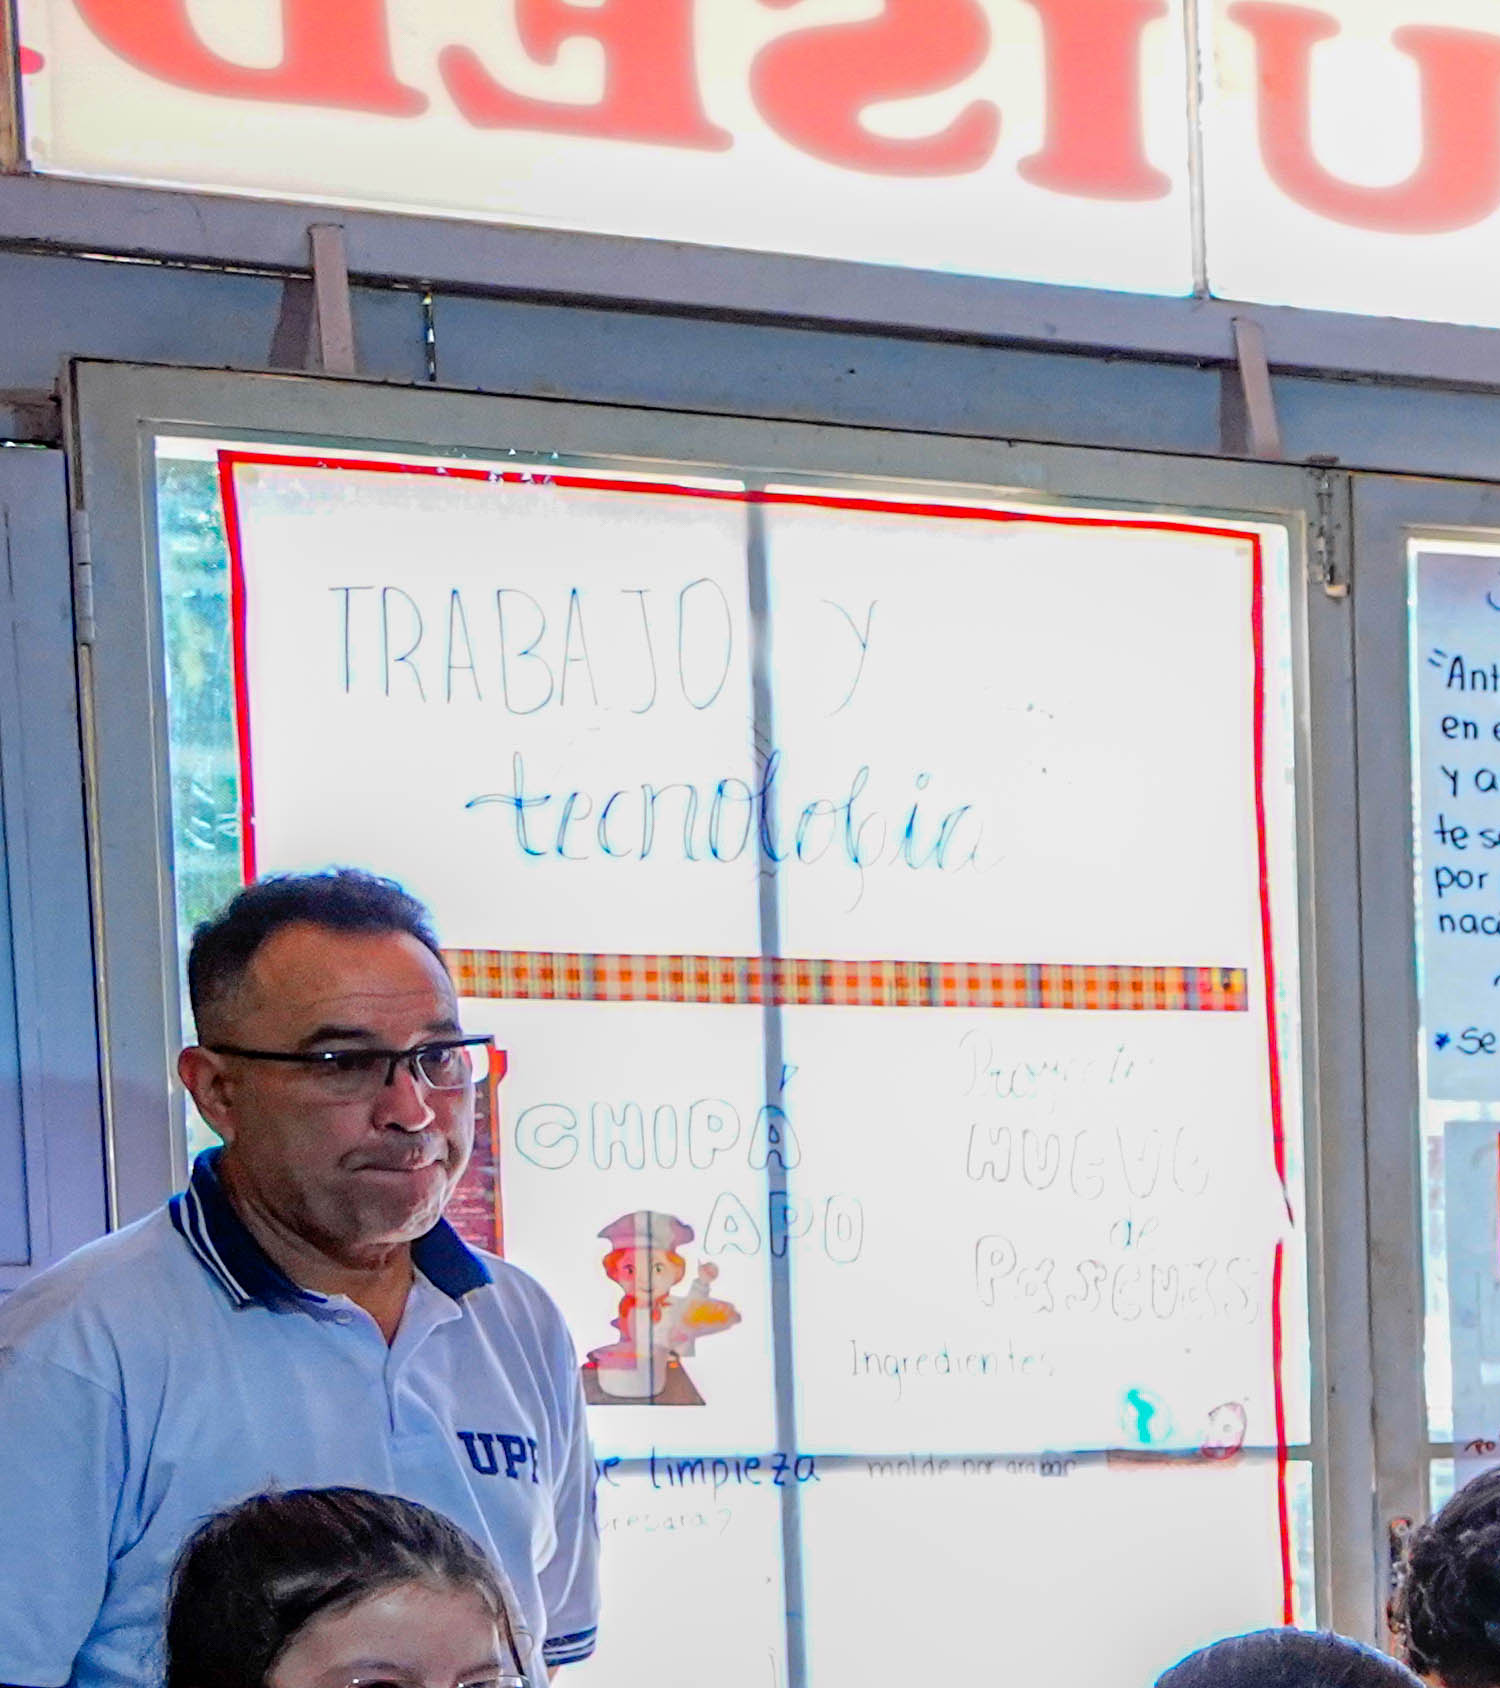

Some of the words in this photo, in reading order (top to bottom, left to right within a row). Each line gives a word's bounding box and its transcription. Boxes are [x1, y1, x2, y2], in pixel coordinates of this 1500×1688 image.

[328, 577, 733, 716] TRABAJO
[1441, 717, 1480, 742] en
[1434, 814, 1466, 851] te
[1434, 866, 1488, 898] por
[1456, 1025, 1497, 1057] Se
[651, 1446, 821, 1501] limpieza
